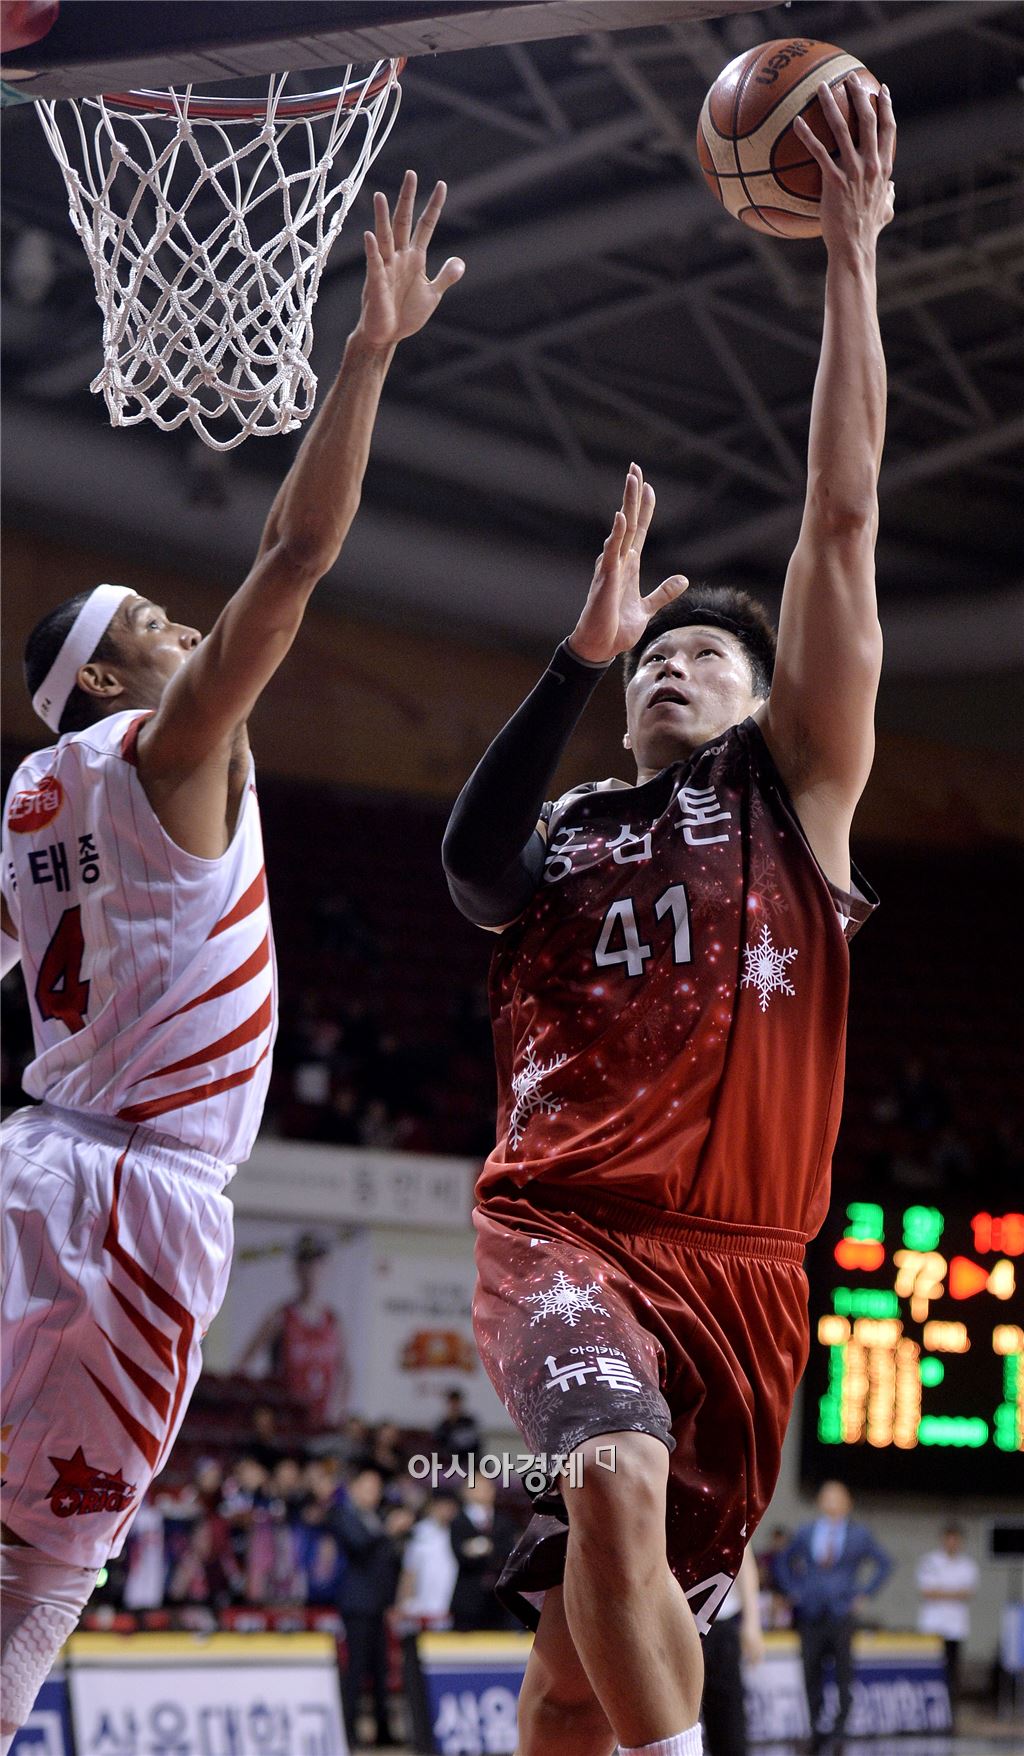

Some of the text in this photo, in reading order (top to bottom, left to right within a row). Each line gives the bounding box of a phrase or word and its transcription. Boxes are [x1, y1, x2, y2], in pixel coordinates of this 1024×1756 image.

[9, 833, 100, 892] 태종
[543, 785, 732, 883] 홍삼톤
[34, 903, 90, 1036] 4
[594, 883, 693, 977] 41
